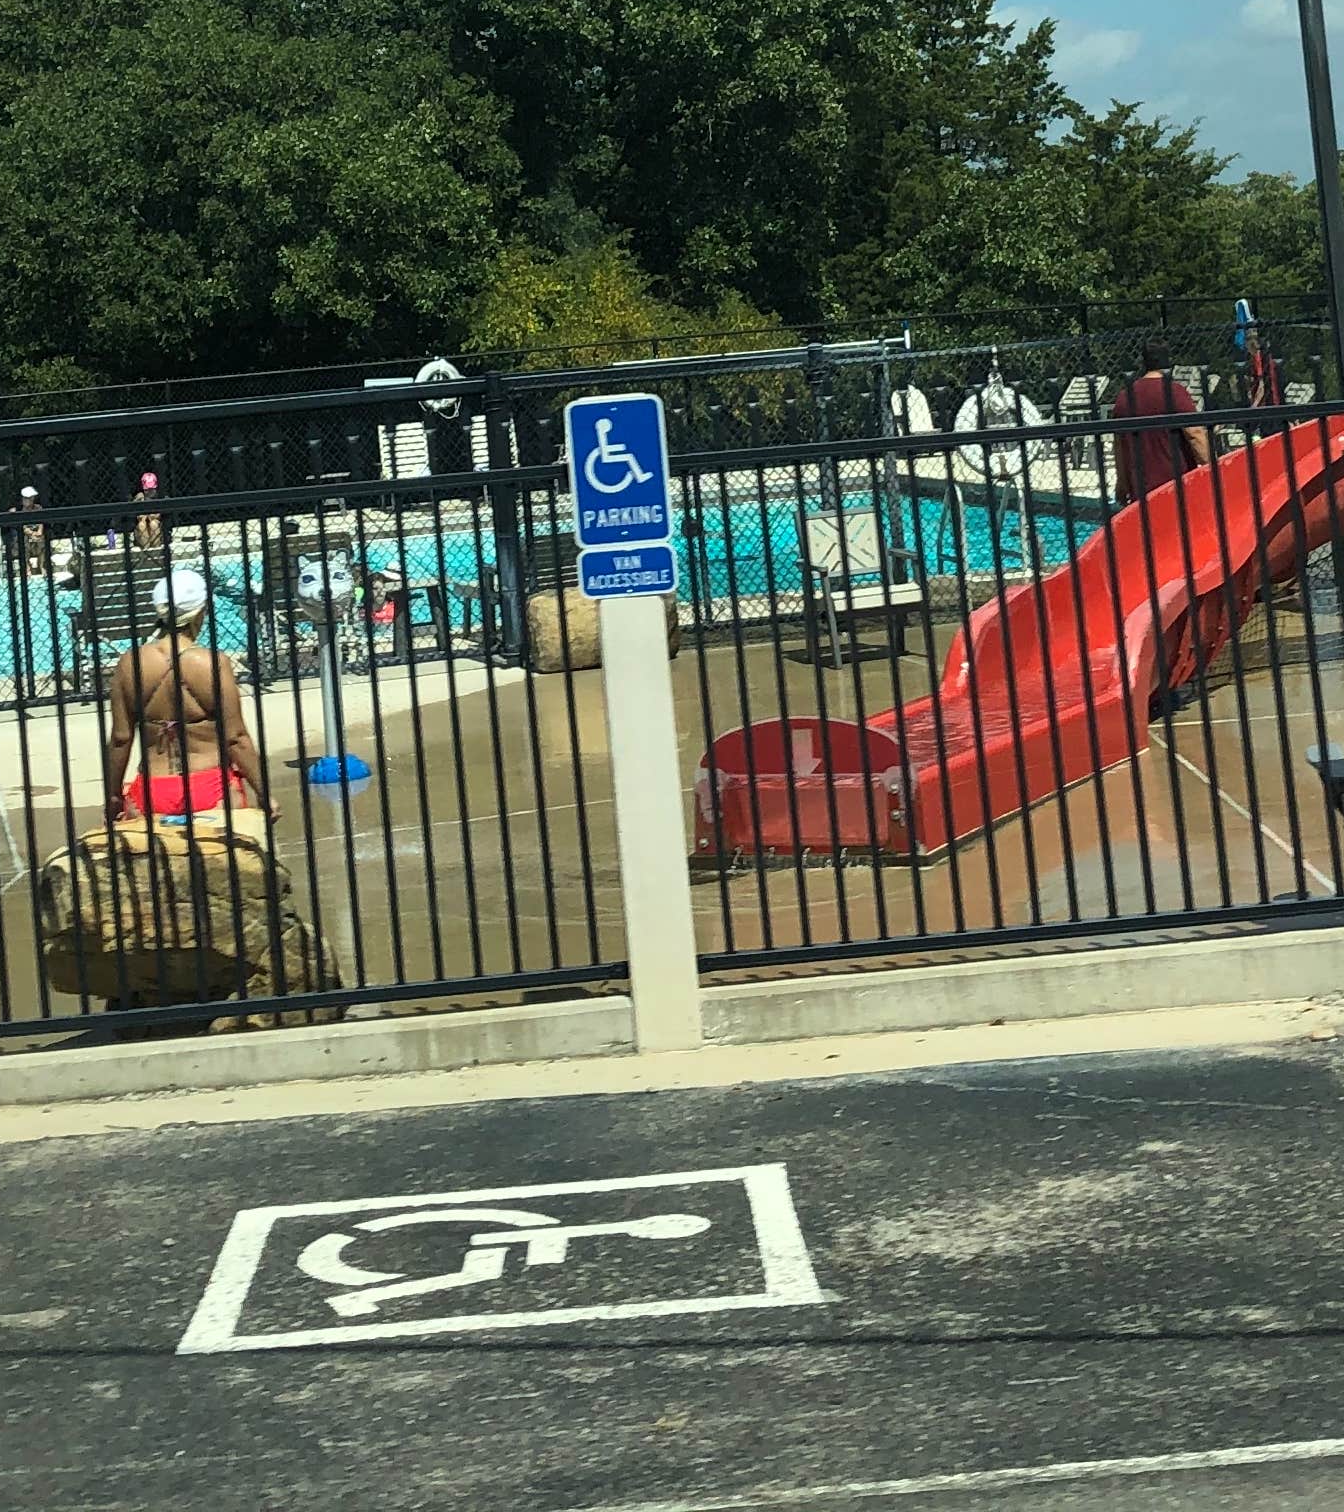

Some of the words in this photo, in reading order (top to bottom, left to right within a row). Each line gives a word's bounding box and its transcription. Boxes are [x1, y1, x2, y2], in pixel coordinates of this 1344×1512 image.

[583, 504, 663, 529] PARKING
[612, 555, 642, 570] VAN
[587, 569, 671, 590] ACCESSIBLE
